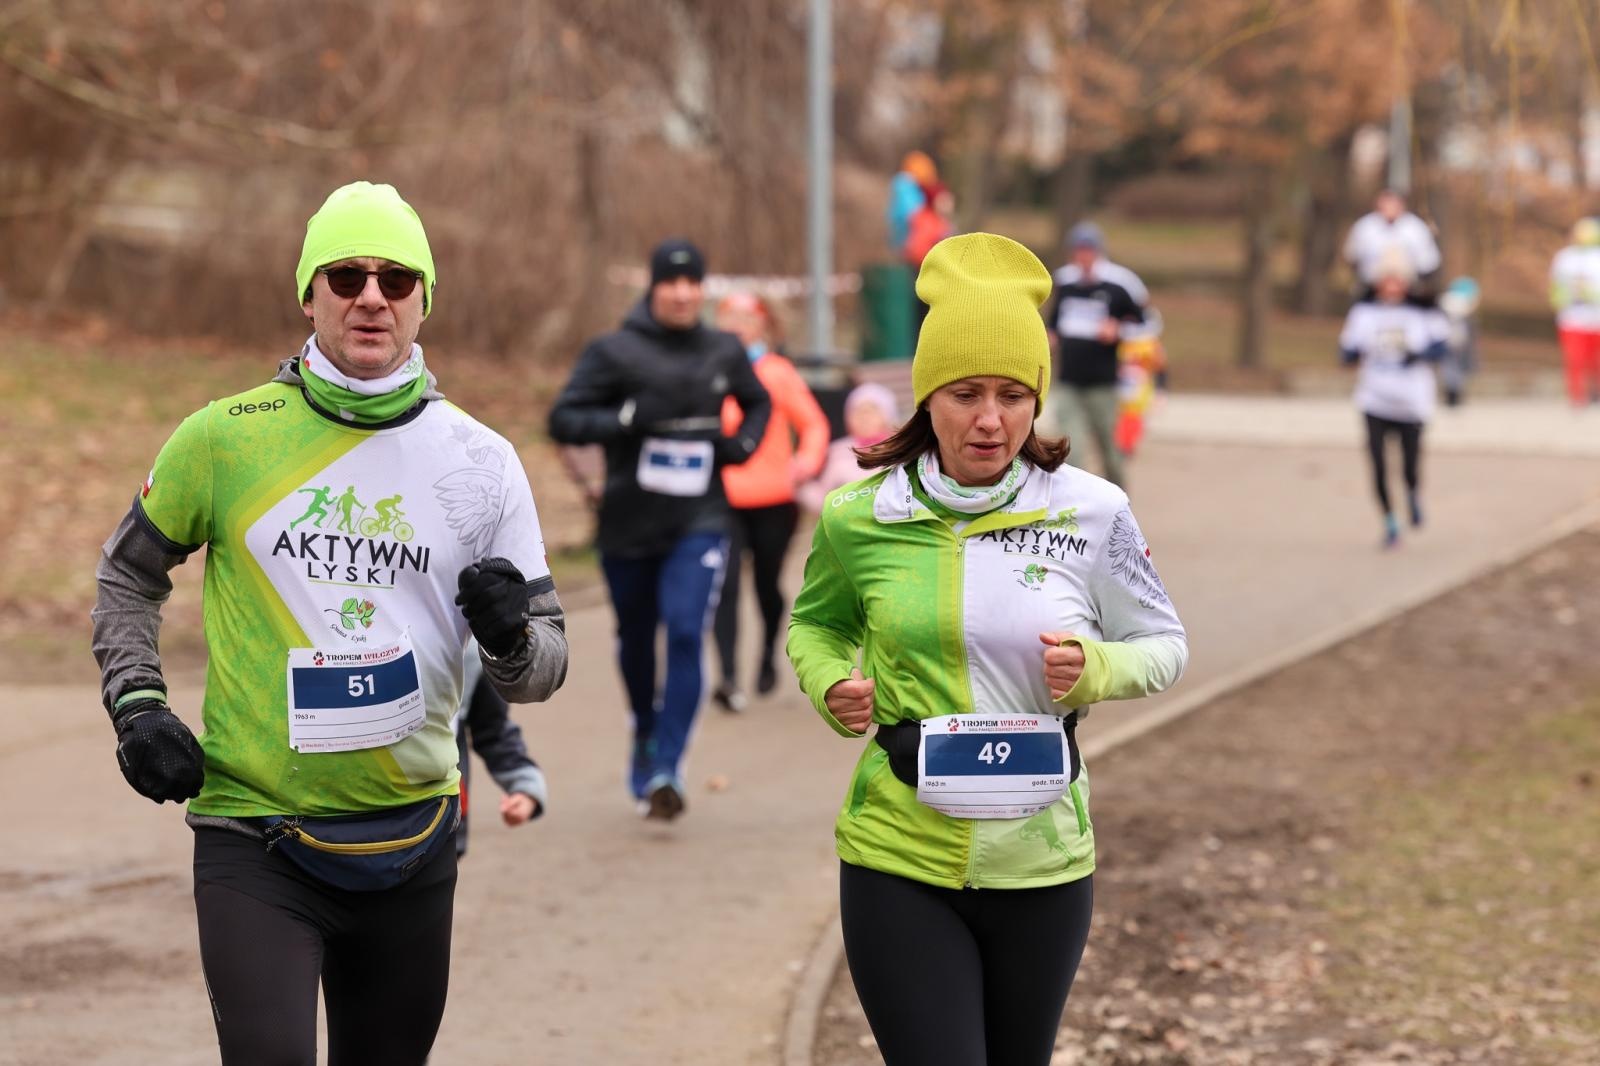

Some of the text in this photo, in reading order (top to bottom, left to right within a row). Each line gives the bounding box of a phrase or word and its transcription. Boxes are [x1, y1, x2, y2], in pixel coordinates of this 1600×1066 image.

[229, 399, 286, 416] deep
[272, 530, 430, 574] AKTYWNI
[980, 527, 1088, 556] AKTYWNI
[1004, 543, 1065, 560] LYSKI
[307, 561, 396, 585] LYSKI
[364, 646, 400, 660] WILCZYM
[348, 673, 375, 697] 51
[977, 741, 1012, 764] 49
